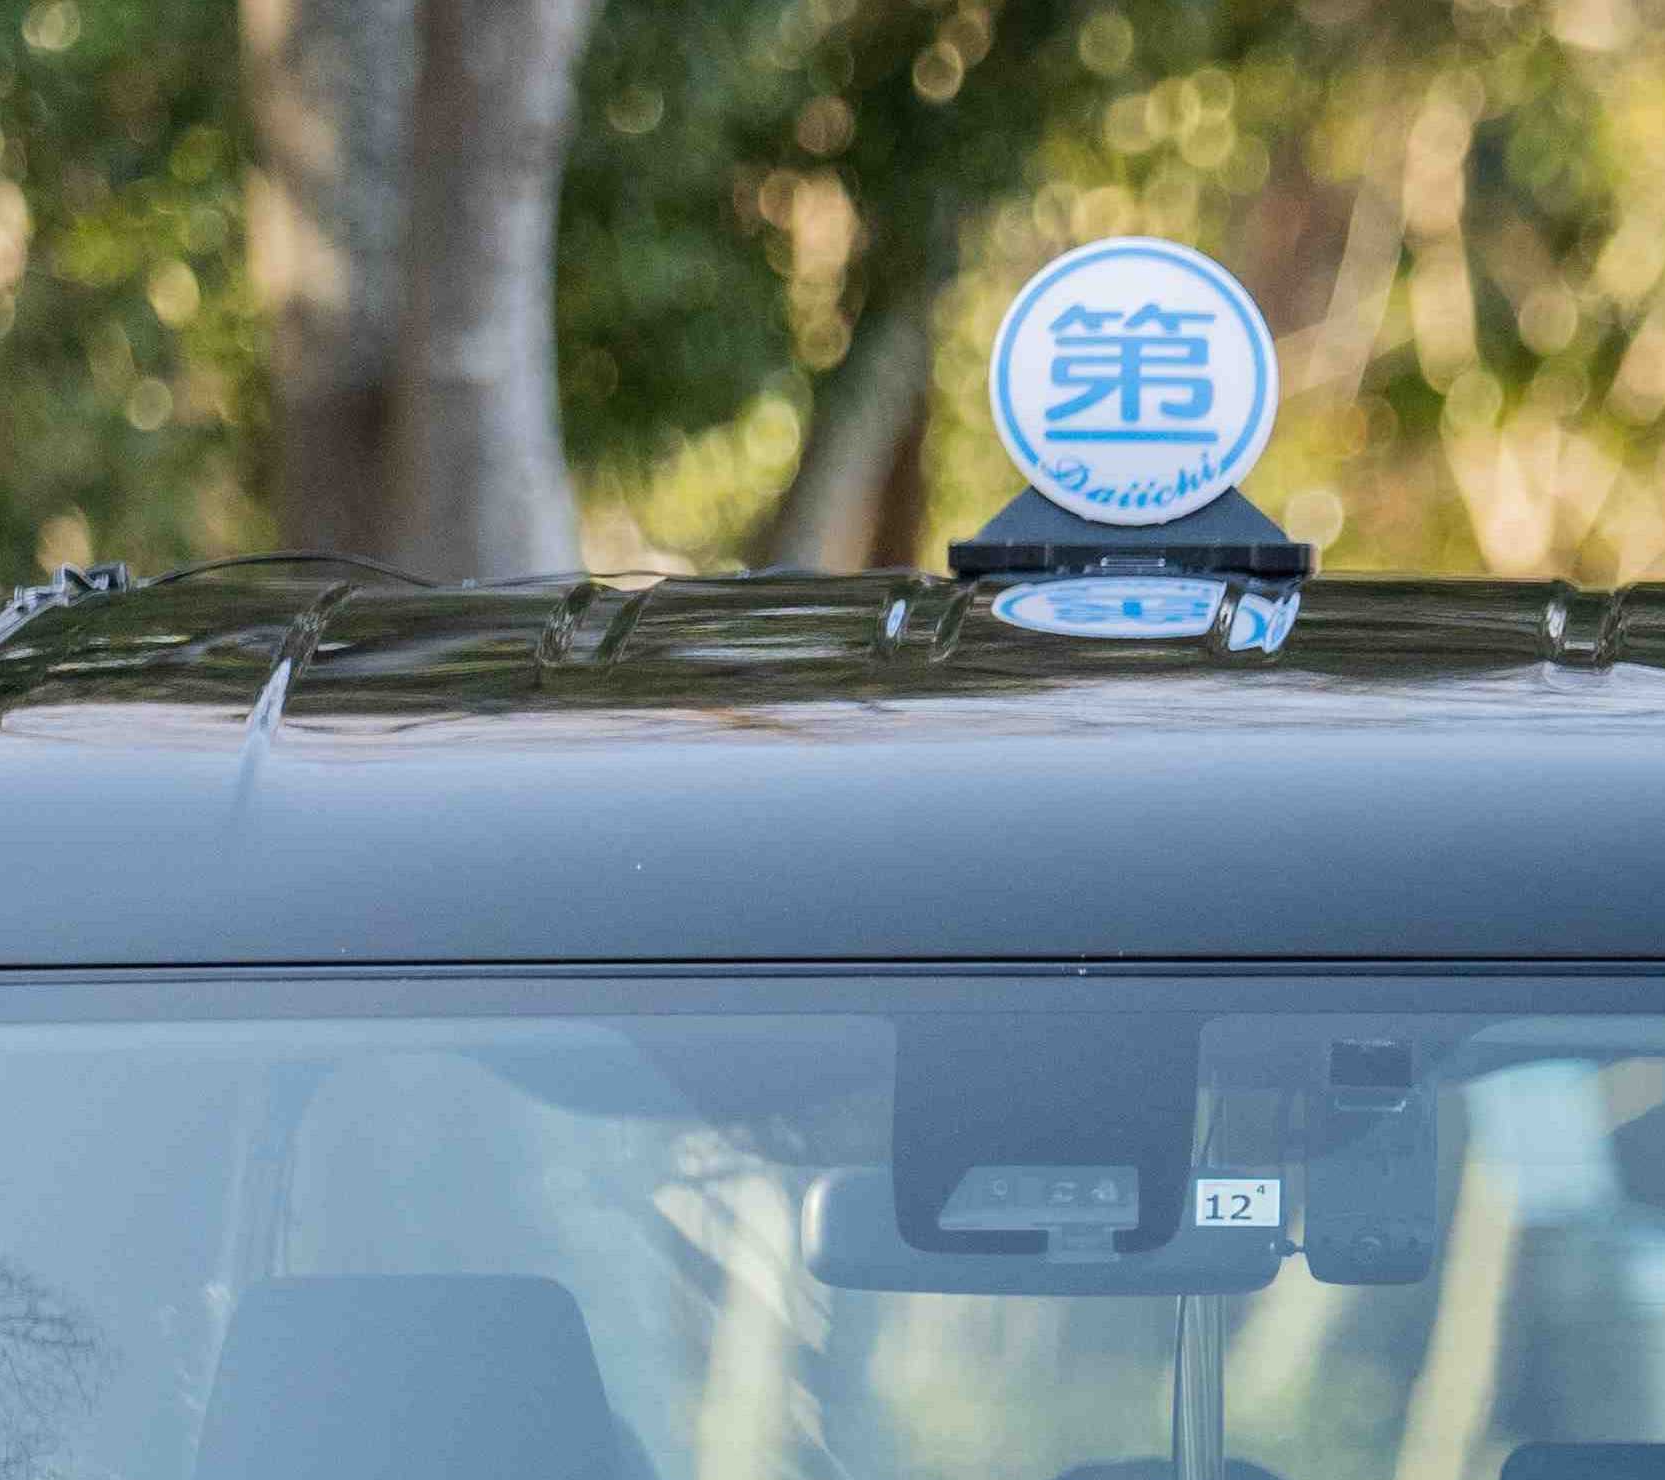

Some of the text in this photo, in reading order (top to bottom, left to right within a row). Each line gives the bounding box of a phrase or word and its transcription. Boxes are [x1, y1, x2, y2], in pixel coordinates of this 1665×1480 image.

[1041, 452, 1218, 509] Daiichi
[1256, 1184, 1266, 1194] 4
[1204, 1194, 1252, 1220] 12
